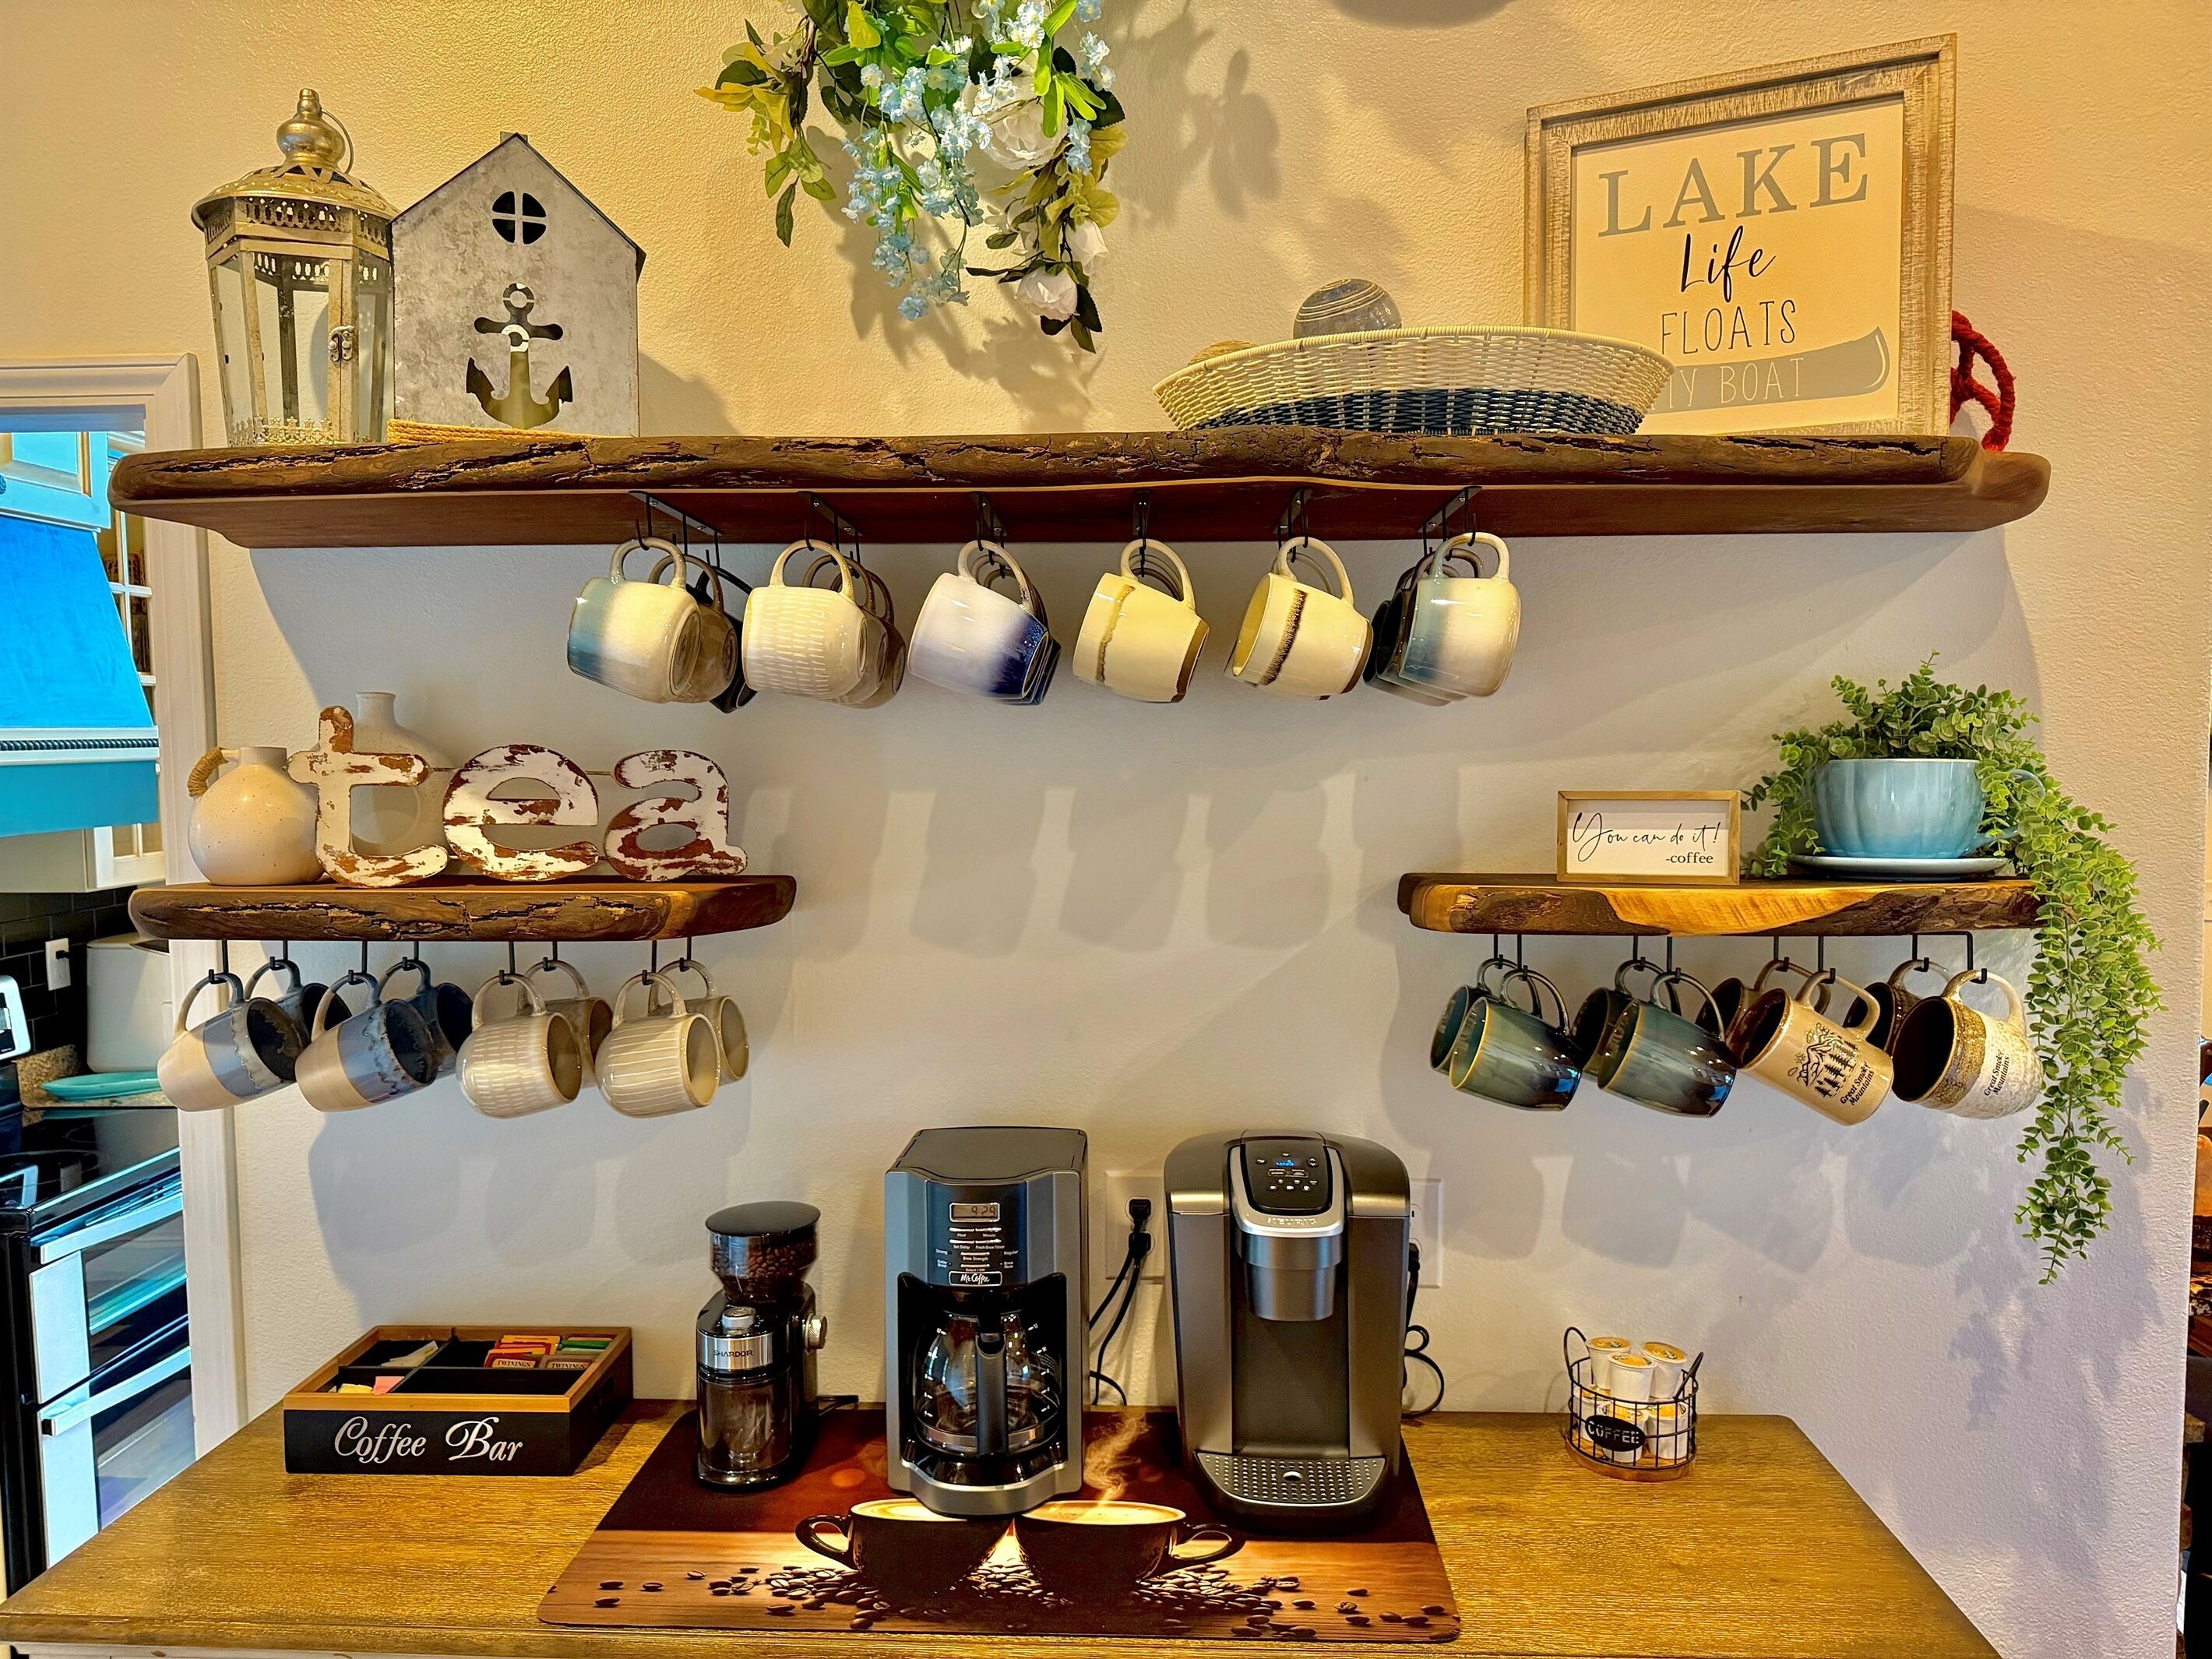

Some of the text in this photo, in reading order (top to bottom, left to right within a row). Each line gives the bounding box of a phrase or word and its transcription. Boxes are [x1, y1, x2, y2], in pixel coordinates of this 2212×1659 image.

[1598, 132, 1869, 238] LAKE
[1680, 225, 1777, 302] Life
[1661, 299, 1796, 355] FLOATS
[1719, 357, 1805, 404] BOAT
[287, 705, 748, 888] tea
[1572, 812, 1721, 862] You can do it!
[1665, 852, 1714, 864] -coffee
[1840, 1084, 1858, 1104] Great
[1849, 1070, 1875, 1105] Mountains
[1984, 1075, 1997, 1096] Great
[1992, 1055, 2009, 1095] Mountains
[334, 1415, 523, 1464] Coffee Bar
[1587, 1420, 1640, 1444] COFFEE
